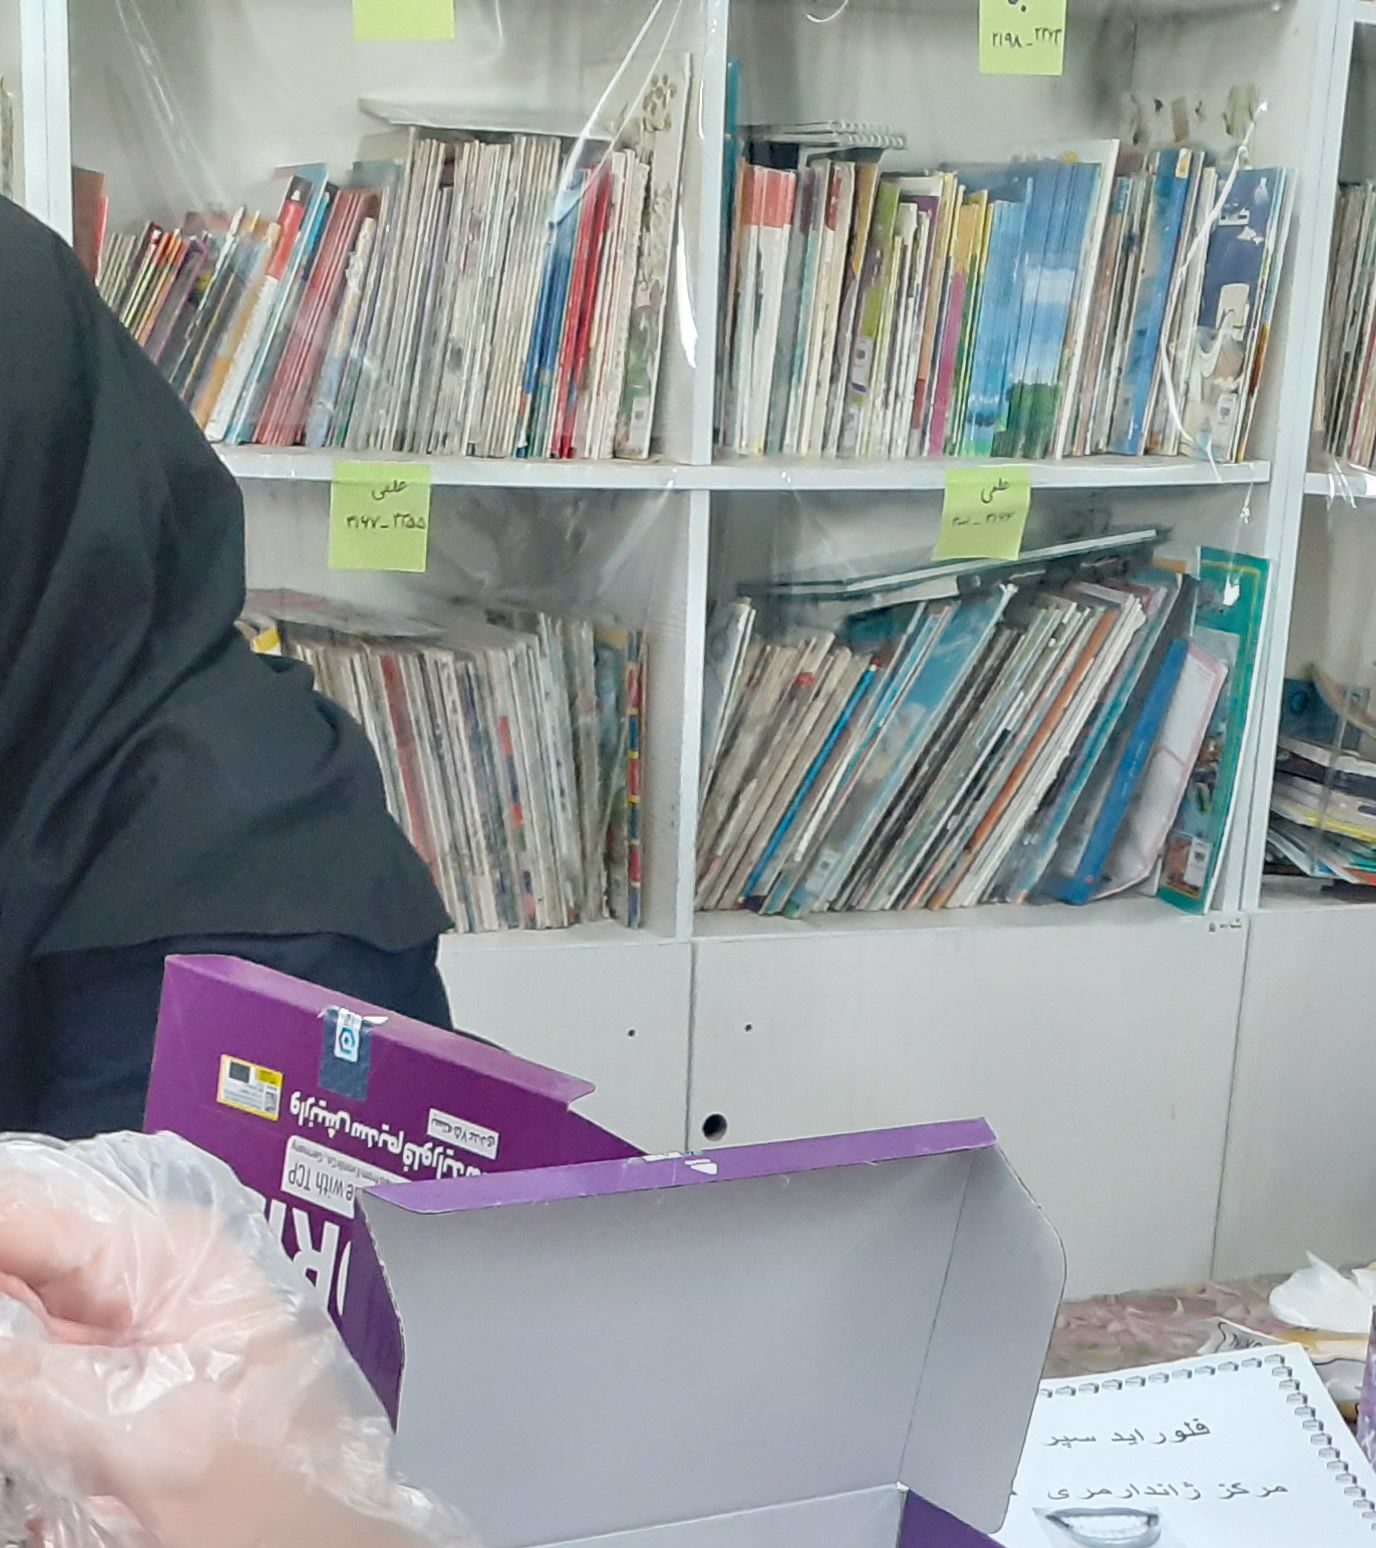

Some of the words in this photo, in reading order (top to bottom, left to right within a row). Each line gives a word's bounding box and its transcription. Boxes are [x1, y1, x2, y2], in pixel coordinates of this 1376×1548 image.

[289, 1090, 352, 1140] وارنیش
[348, 1119, 404, 1156] سدیم
[285, 1161, 315, 1191] TCP
[313, 1172, 346, 1199] with
[1044, 1429, 1097, 1448] سپر
[1218, 1481, 1289, 1499] مرکز
